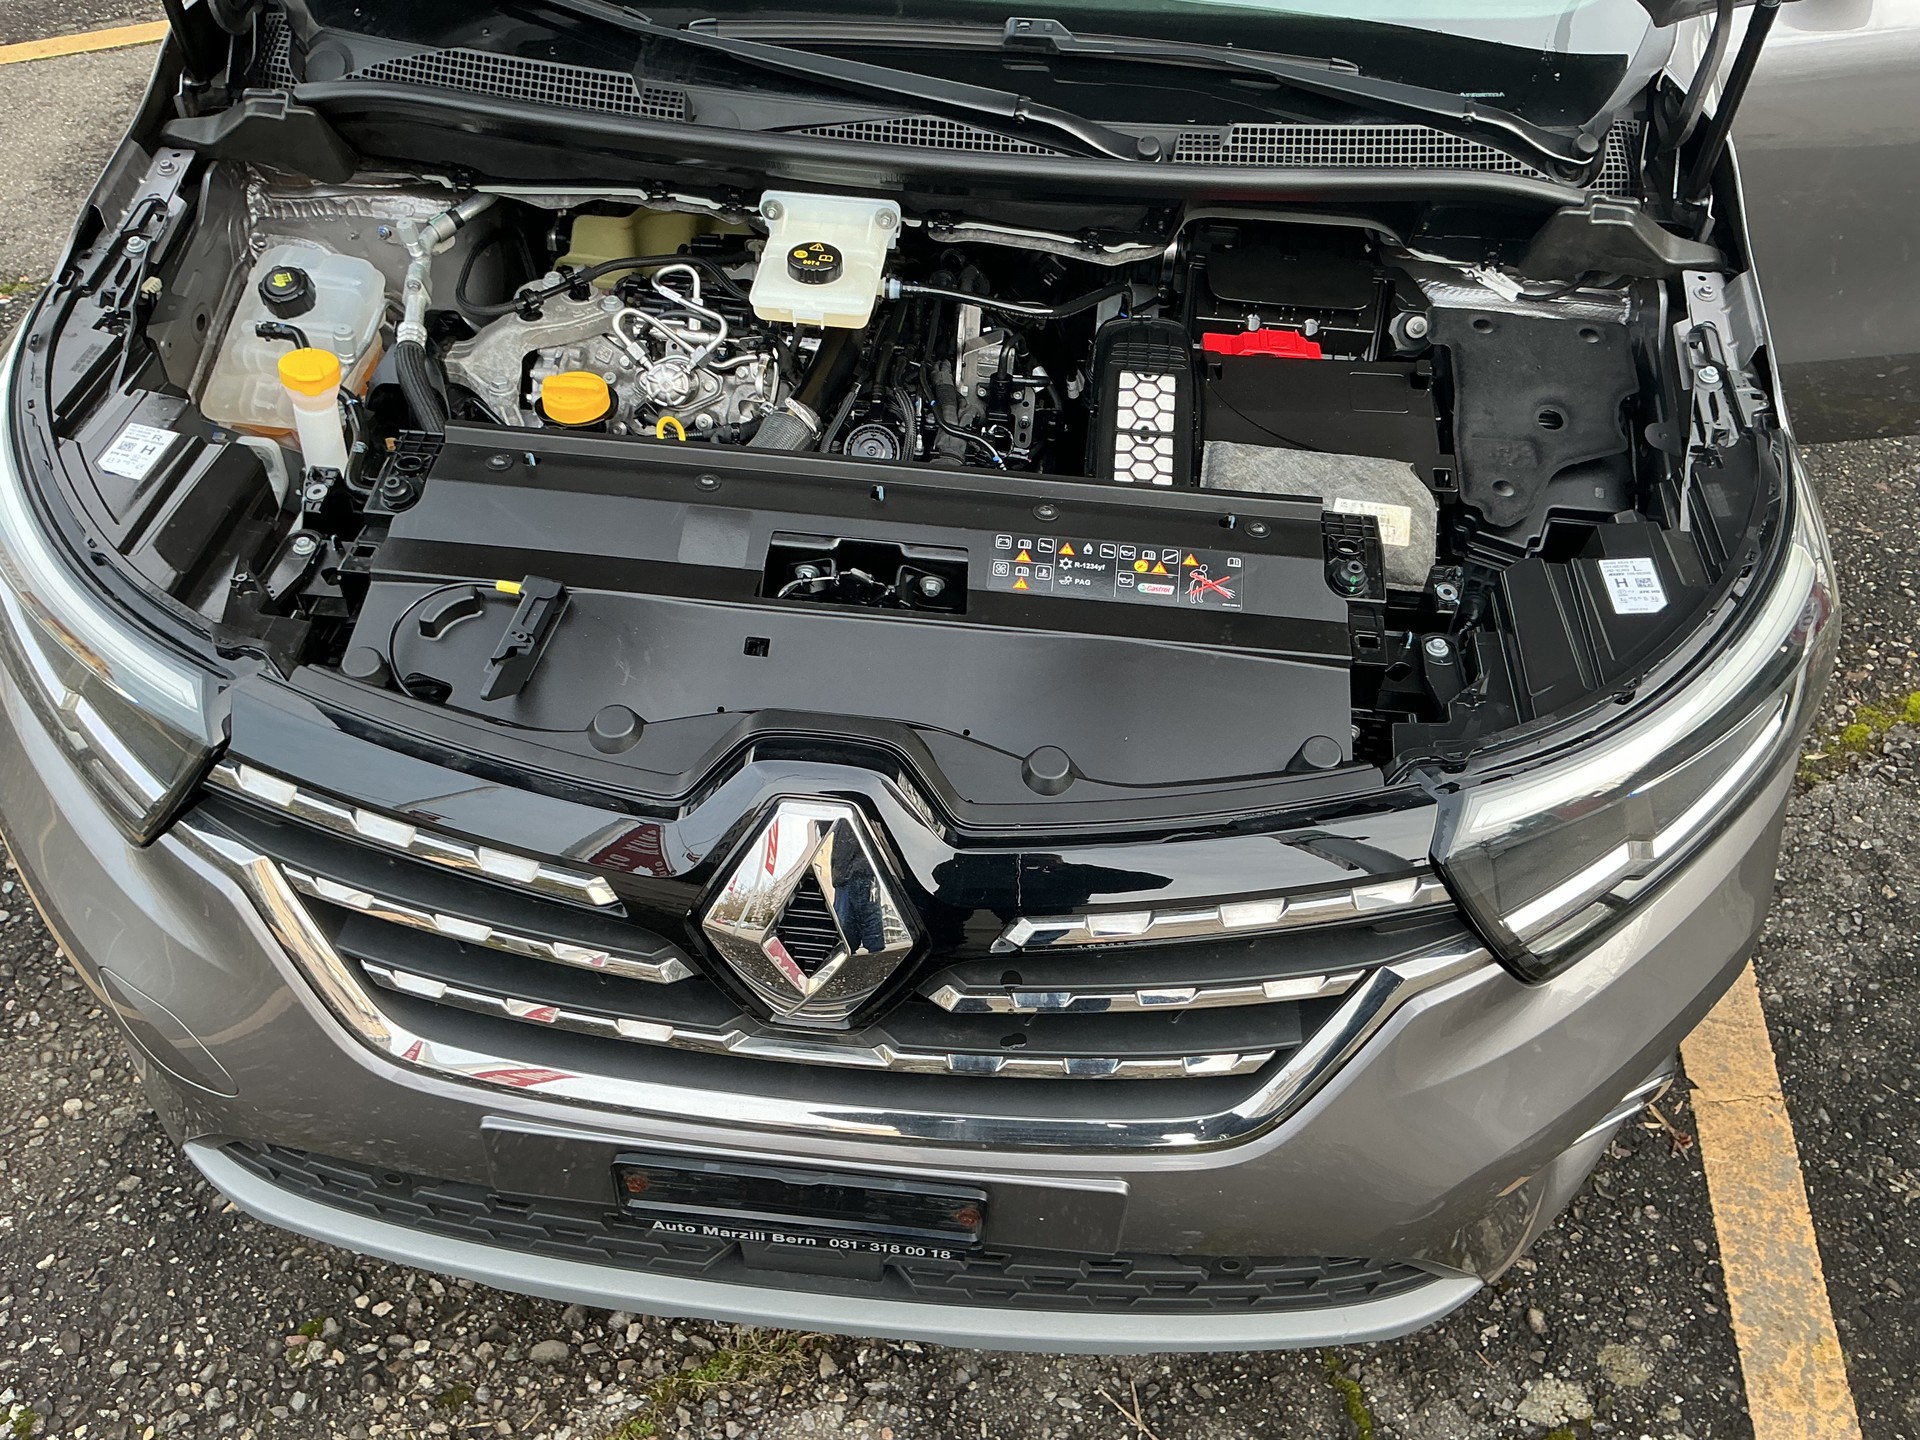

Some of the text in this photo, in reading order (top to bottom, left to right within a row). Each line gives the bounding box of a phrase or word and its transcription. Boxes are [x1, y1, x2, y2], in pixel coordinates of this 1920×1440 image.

[140, 445, 156, 455] H
[1074, 562, 1105, 571] R-1234yf
[1074, 578, 1091, 586] PAG
[1614, 578, 1629, 588] H
[1146, 585, 1171, 593] Castrol
[652, 1220, 696, 1233] Auto
[702, 1225, 766, 1241] Marzili
[771, 1232, 817, 1246] Bern
[904, 1246, 925, 1256] 00
[930, 1249, 951, 1259] 18
